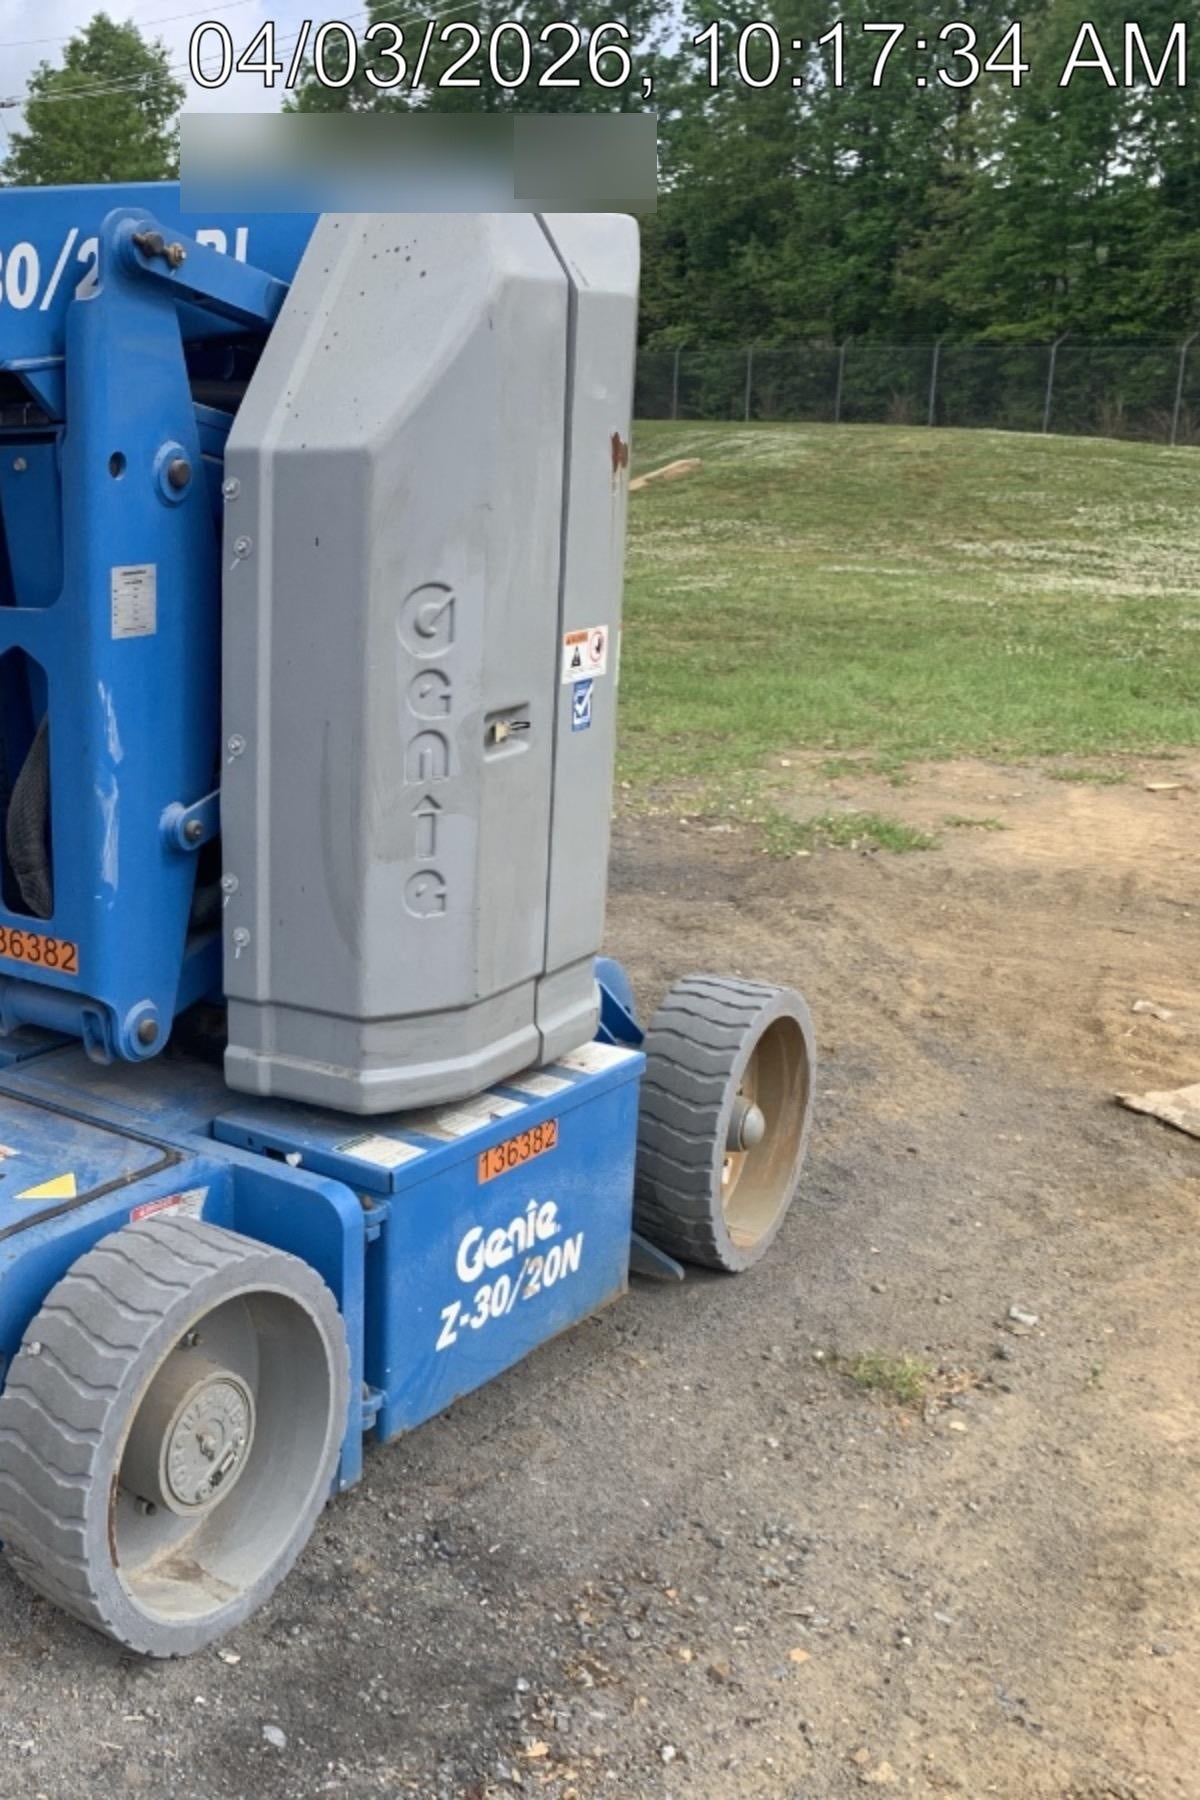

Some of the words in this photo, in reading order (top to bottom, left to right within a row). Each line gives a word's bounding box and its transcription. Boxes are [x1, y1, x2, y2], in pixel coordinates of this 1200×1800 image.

[481, 1119, 557, 1179] 136382
[456, 1198, 559, 1283] Genie
[435, 1232, 584, 1352] Z-30/20N
